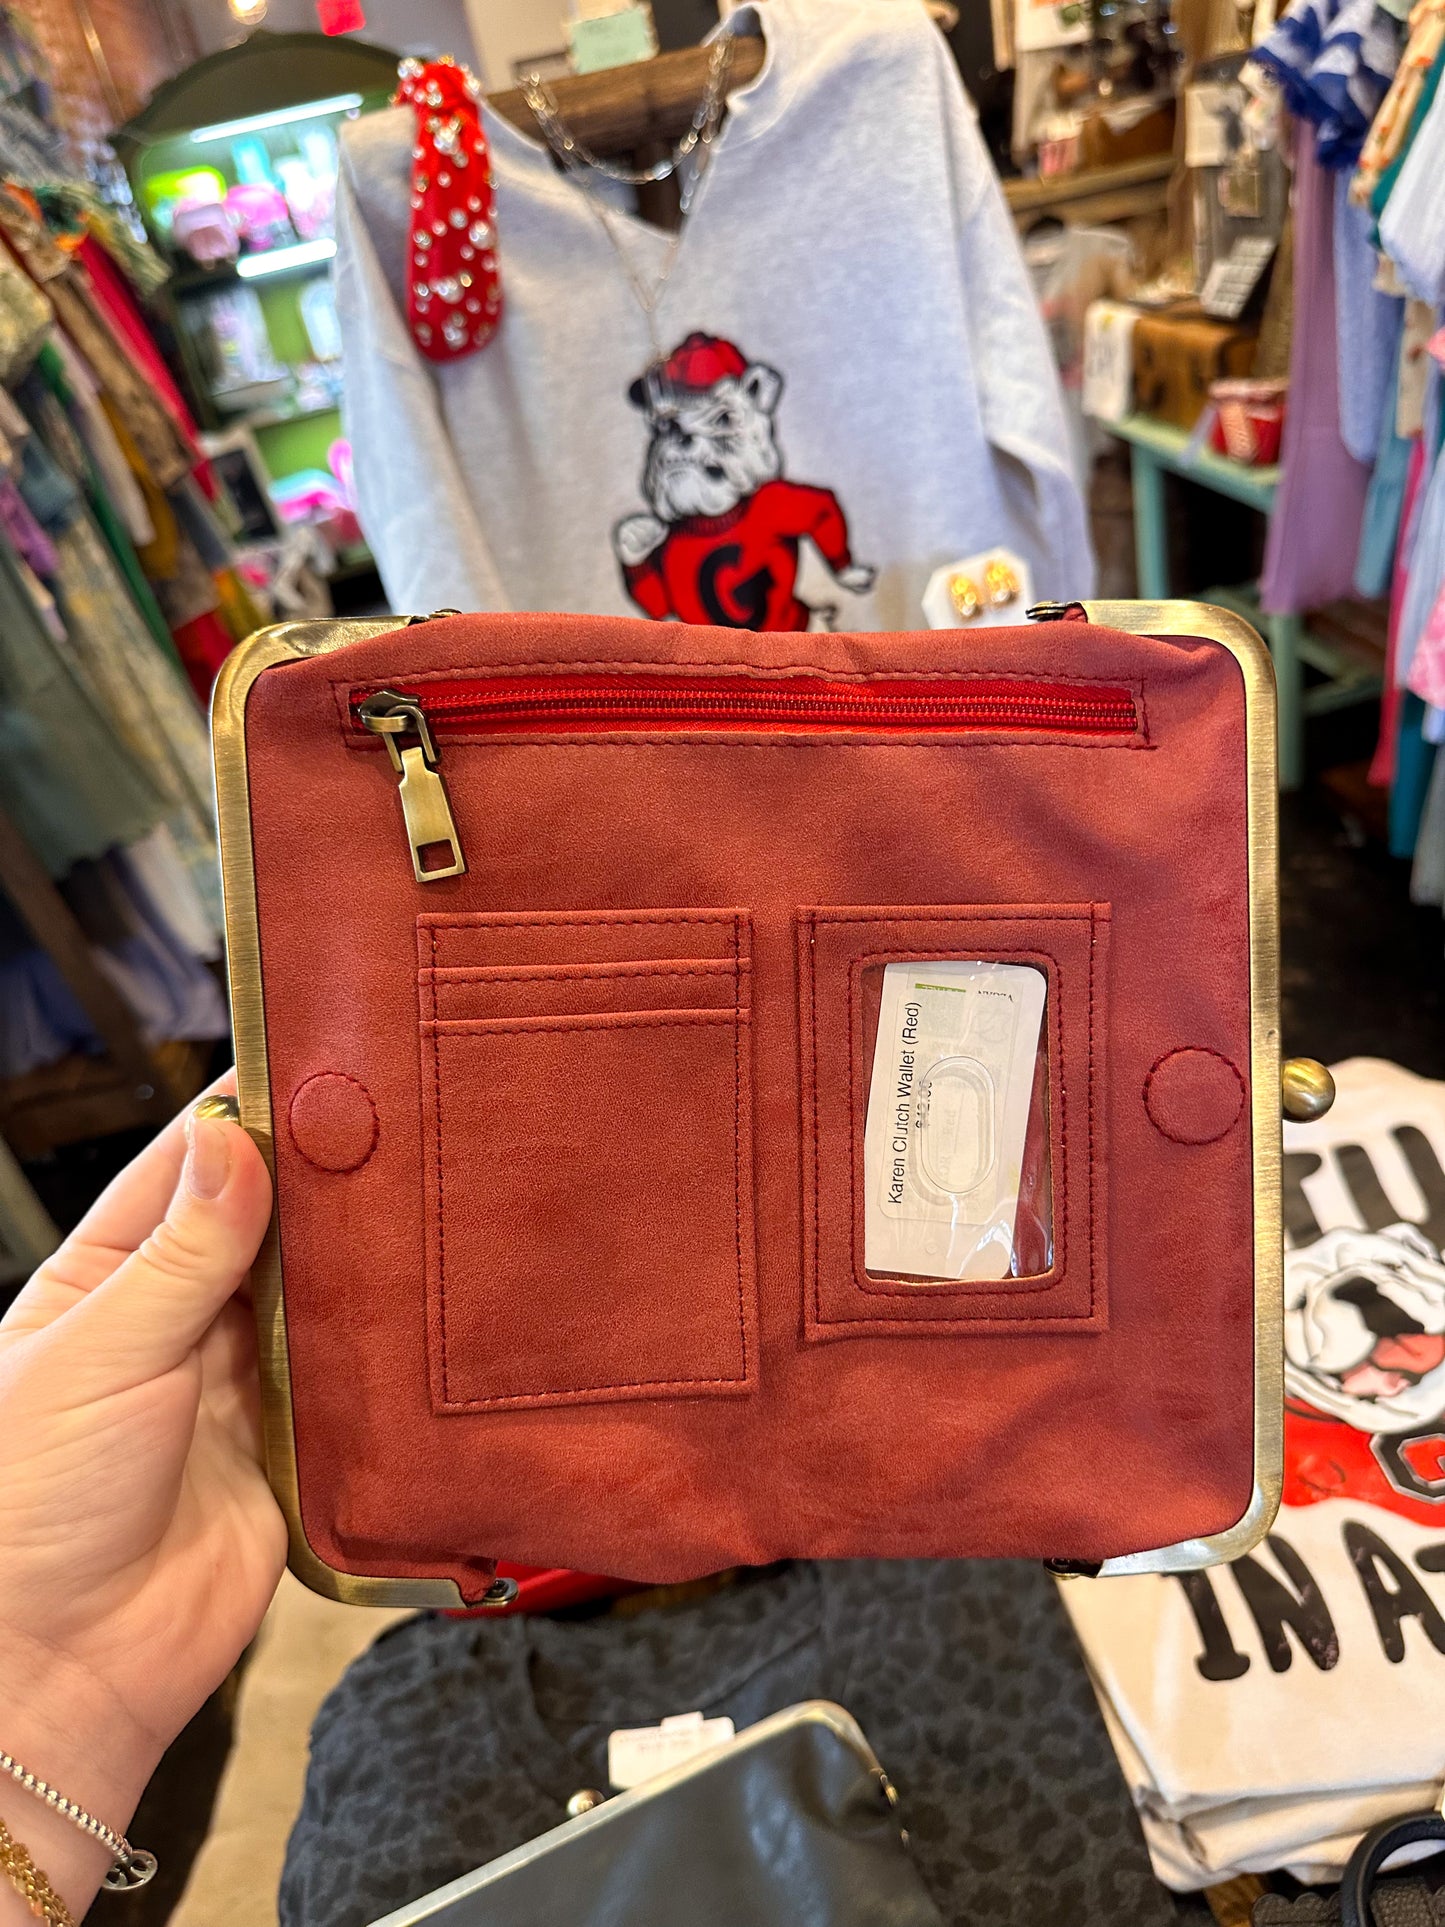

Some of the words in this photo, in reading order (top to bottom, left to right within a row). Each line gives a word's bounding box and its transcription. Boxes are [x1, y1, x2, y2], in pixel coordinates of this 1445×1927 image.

[697, 543, 776, 633] G
[901, 1002, 922, 1045] (Red)
[897, 1050, 915, 1098] Wallet
[892, 1103, 910, 1153] Clutch
[887, 1158, 906, 1204] Karen
[1162, 1534, 1340, 1681] IN
